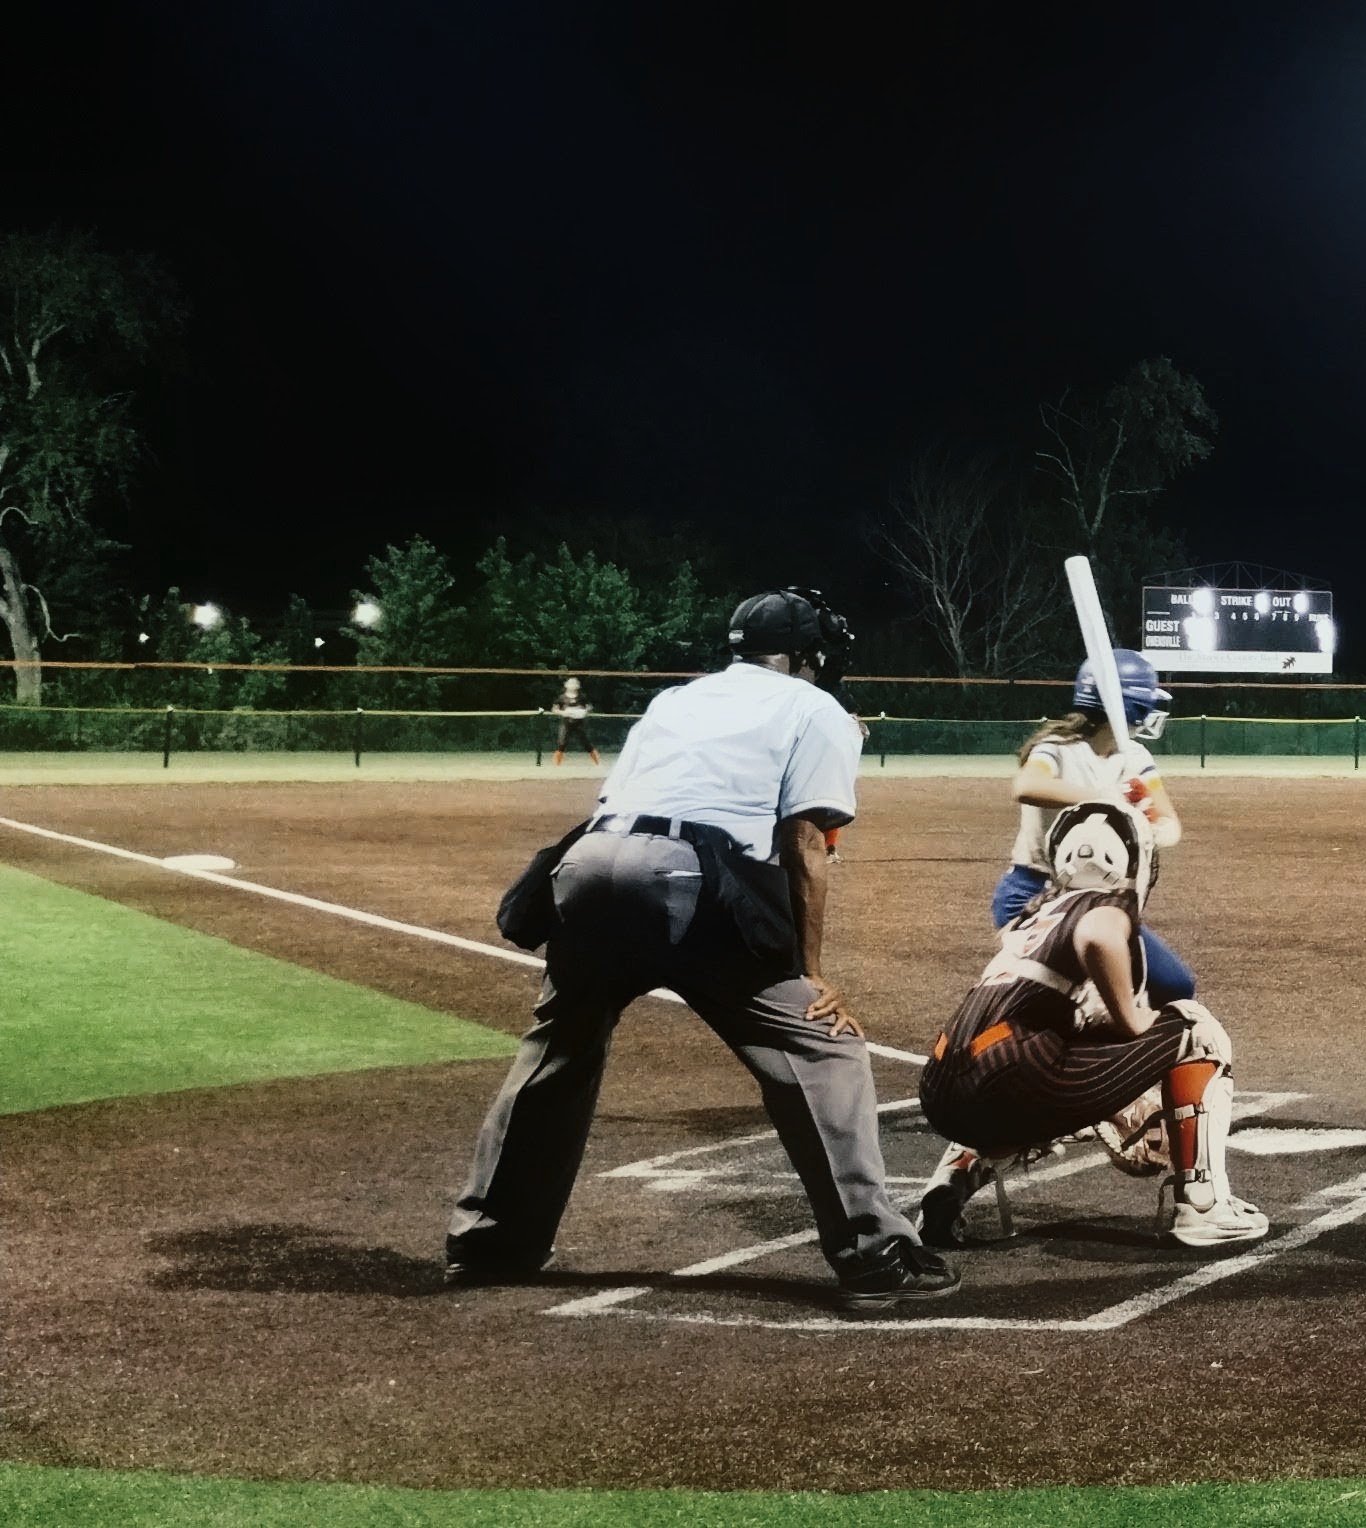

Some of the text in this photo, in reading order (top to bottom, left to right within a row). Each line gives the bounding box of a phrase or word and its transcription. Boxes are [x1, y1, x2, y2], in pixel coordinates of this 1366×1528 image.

[1220, 595, 1253, 606] STRIKE
[1272, 596, 1292, 607] OUT
[1230, 612, 1236, 620] 4
[1271, 613, 1277, 621] 7
[1145, 619, 1180, 632] GUEST
